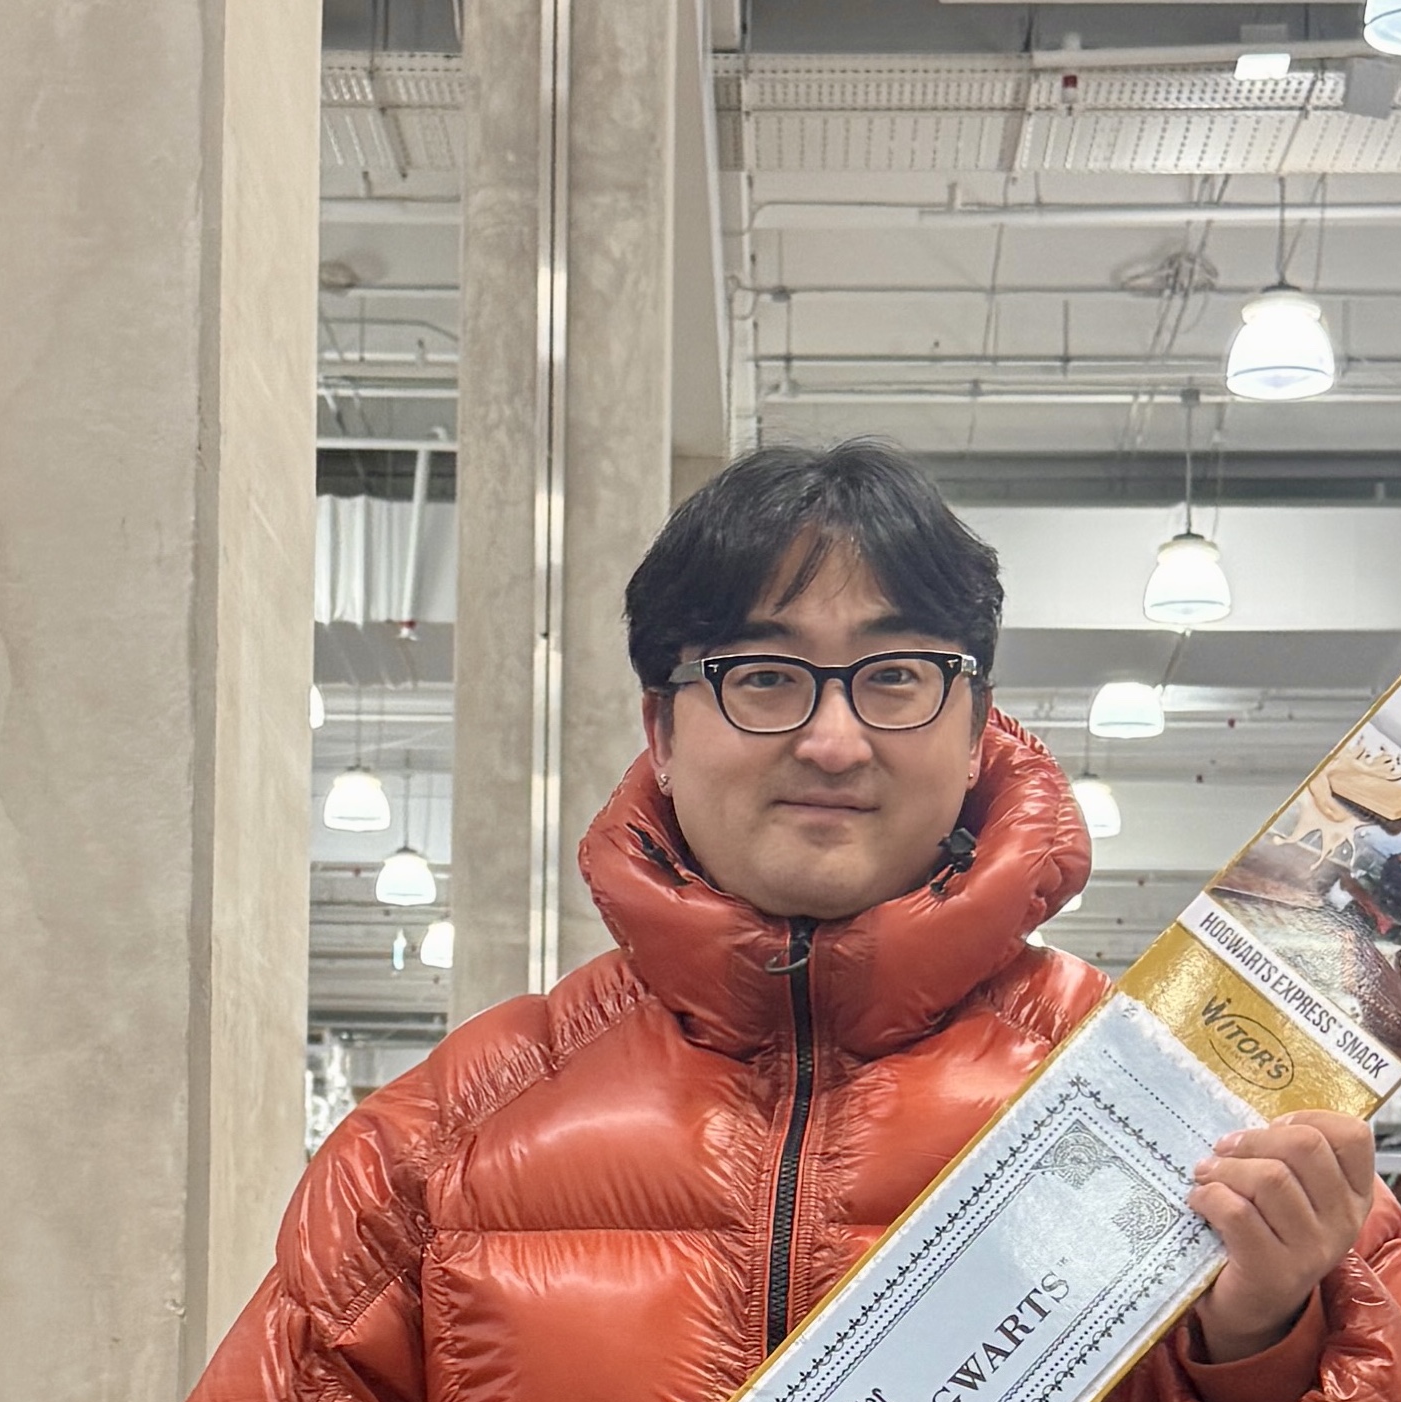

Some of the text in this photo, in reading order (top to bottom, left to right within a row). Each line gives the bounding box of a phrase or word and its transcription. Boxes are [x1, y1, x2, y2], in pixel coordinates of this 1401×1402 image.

[1199, 912, 1389, 1079] HOGWARTS EXPRESS SNACK
[1201, 993, 1290, 1081] WITOR'S
